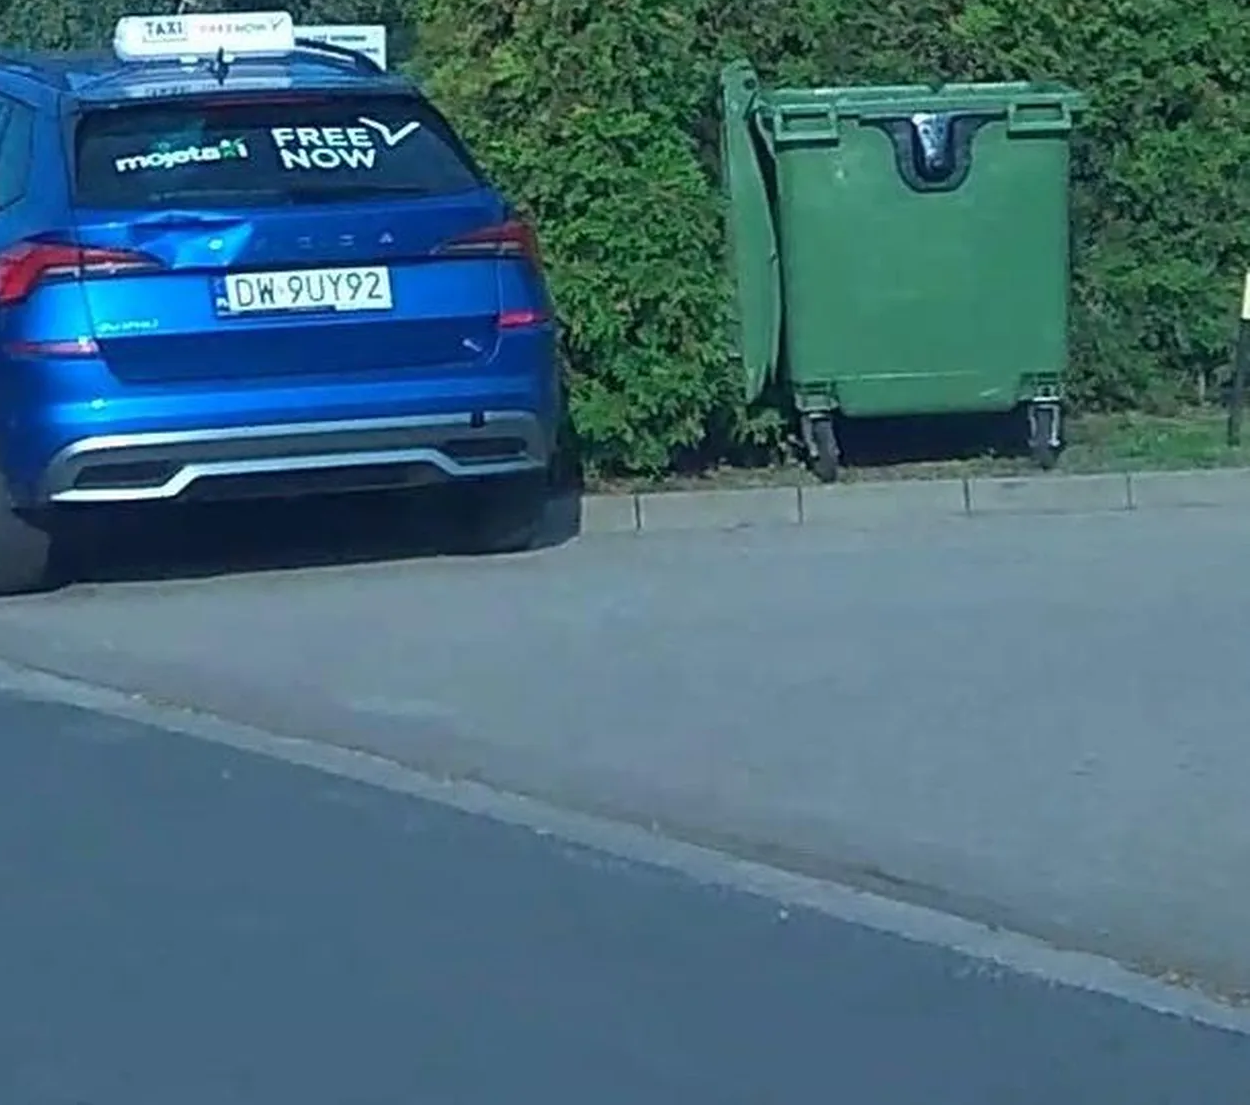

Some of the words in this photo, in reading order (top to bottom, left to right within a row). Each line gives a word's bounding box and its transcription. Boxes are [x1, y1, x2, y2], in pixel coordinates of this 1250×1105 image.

[144, 21, 183, 36] TAXI
[271, 126, 373, 148] FREE
[279, 147, 377, 169] NOW
[235, 277, 276, 307] DW
[287, 271, 383, 303] 9UY92
